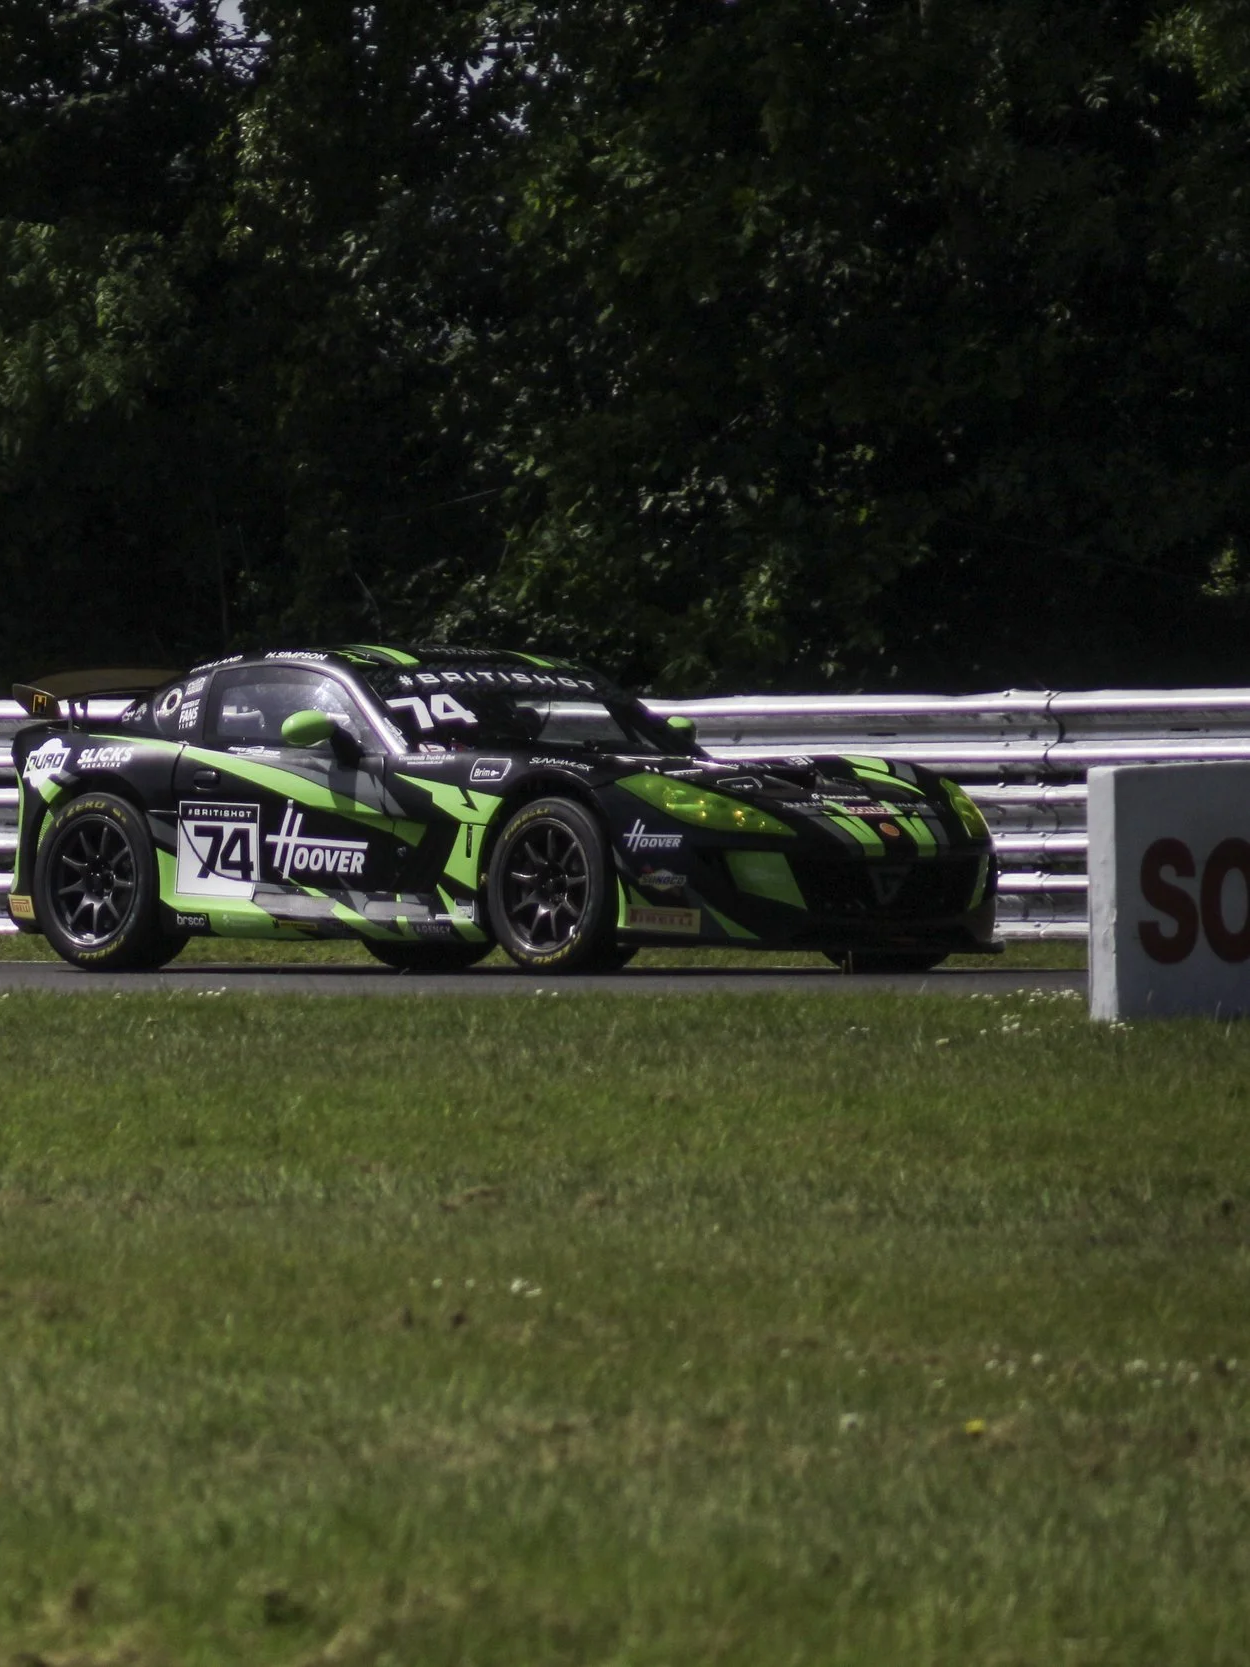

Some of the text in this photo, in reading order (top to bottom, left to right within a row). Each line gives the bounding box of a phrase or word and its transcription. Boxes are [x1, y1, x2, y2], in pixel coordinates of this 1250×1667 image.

[265, 651, 328, 661] H.SIMPSON
[399, 671, 595, 692] #BRITISHGT
[385, 694, 479, 729] 74
[77, 747, 134, 764] SLICKS
[265, 800, 368, 880] HOOVER
[623, 819, 683, 852] HOOVER
[194, 824, 254, 880] 74
[176, 913, 206, 926] brscc
